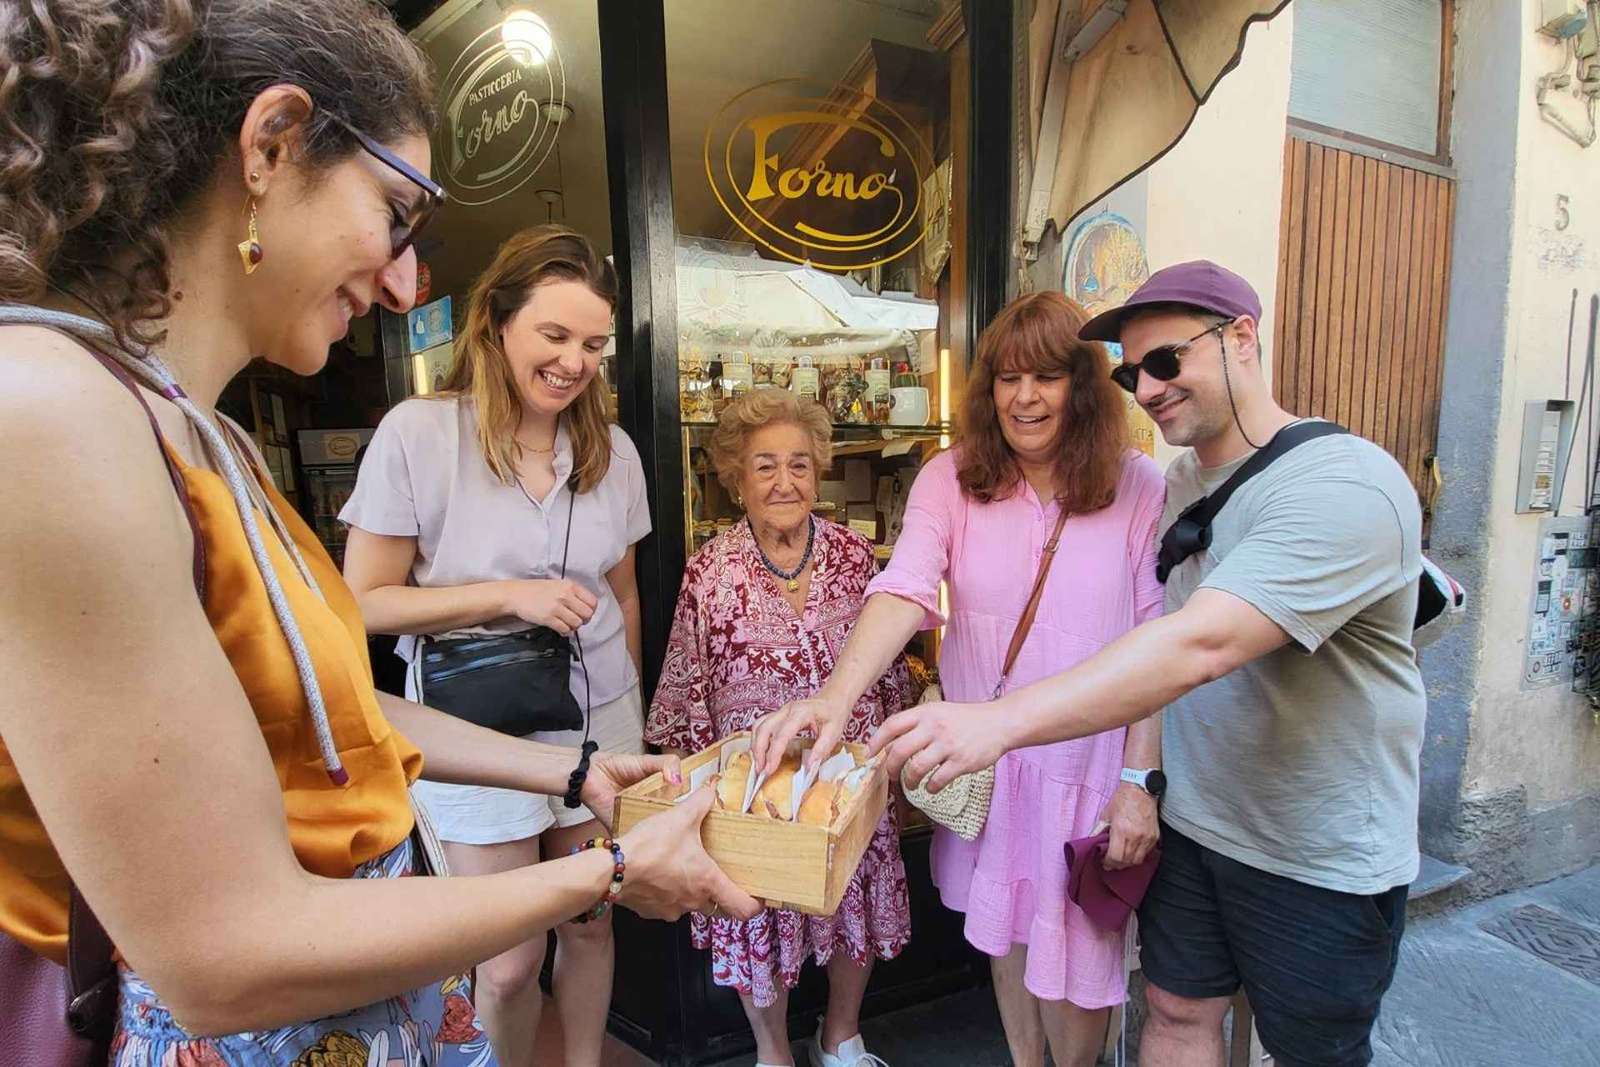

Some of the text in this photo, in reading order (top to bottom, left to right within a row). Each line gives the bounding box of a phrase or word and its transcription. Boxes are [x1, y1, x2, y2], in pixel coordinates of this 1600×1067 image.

[469, 68, 522, 106] PASTICCERIA
[745, 111, 894, 201] Forno
[1555, 193, 1570, 232] 5
